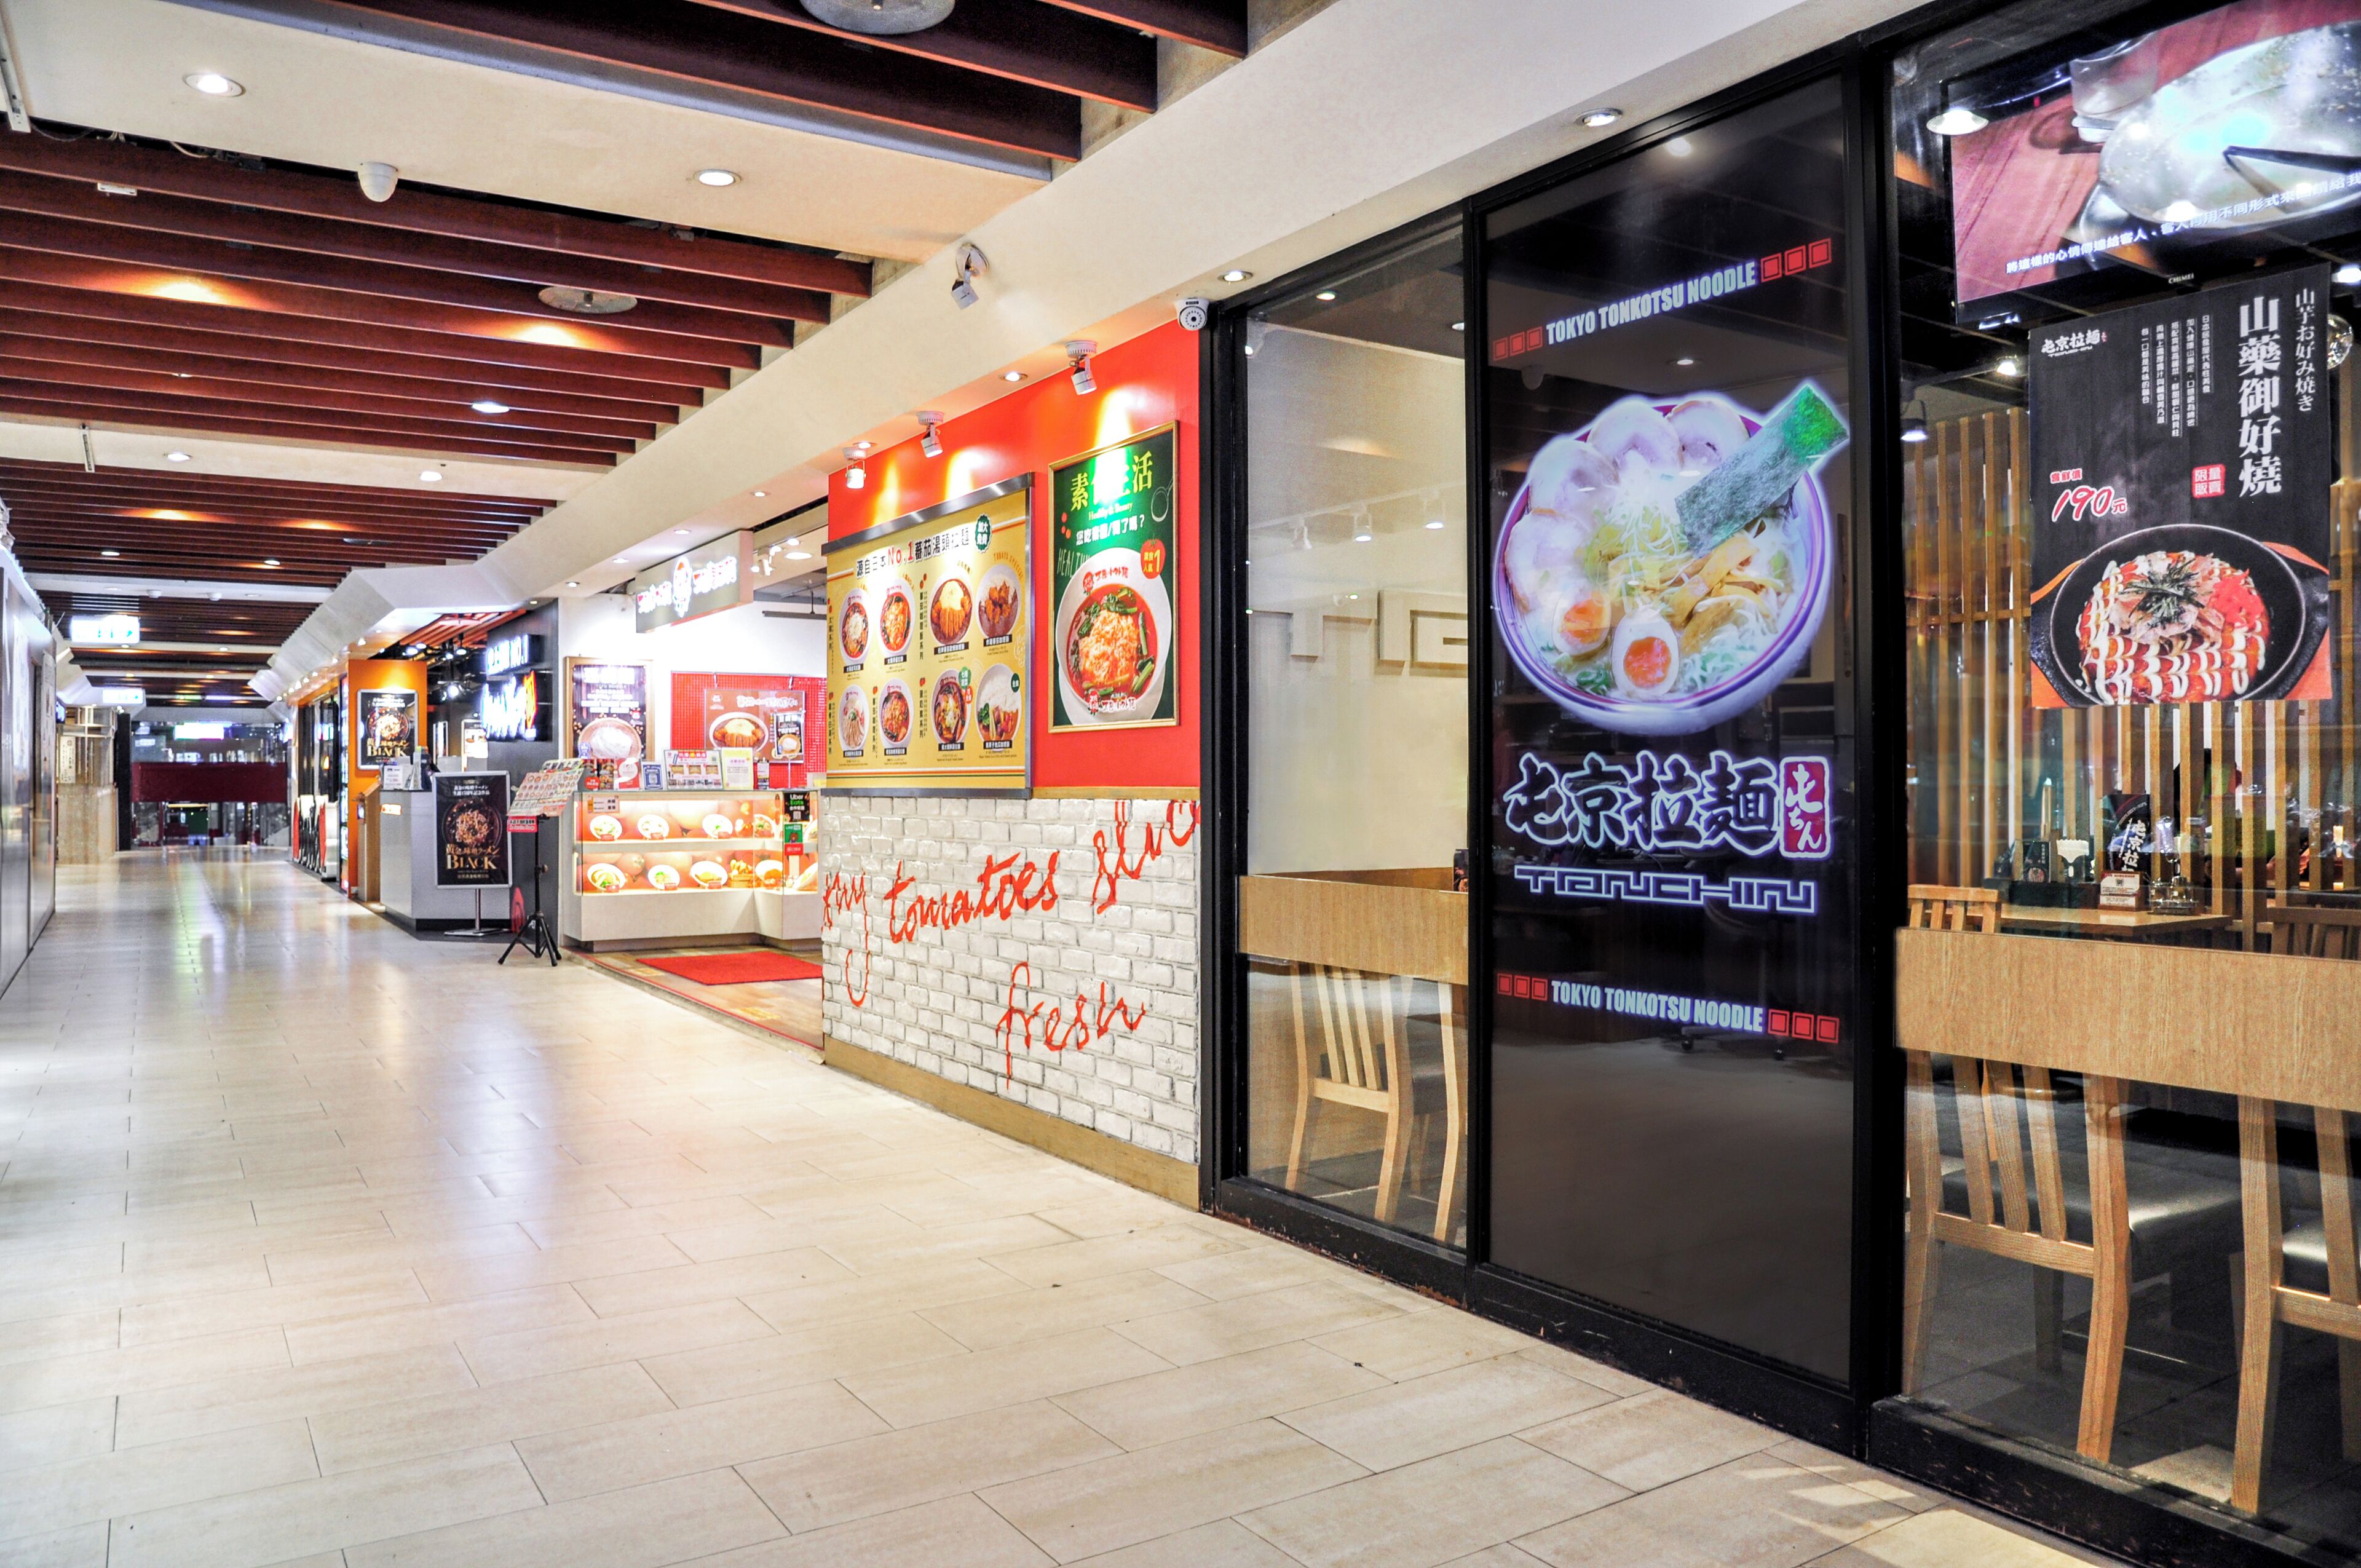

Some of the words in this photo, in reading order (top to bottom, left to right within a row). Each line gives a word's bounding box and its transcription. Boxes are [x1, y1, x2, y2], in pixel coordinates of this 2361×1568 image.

[1546, 311, 1596, 346] TOKYO
[1599, 283, 1684, 331] TONKOTSU
[1687, 261, 1756, 305] NOODLE
[2169, 273, 2194, 284] CHIMEI
[2296, 288, 2316, 411] 山芋お好み焼き
[2238, 296, 2282, 497] 山藥御好燒
[2194, 467, 2221, 482] 限量
[2052, 485, 2127, 522] 190元
[1154, 549, 1161, 572] 1
[446, 854, 497, 870] BLACK
[884, 852, 1059, 943] tomatoes
[996, 961, 1147, 1091] fresh
[1551, 980, 1600, 1009] TOKYO
[1604, 987, 1691, 1021] TONKOTSU
[1694, 999, 1763, 1033] NOODLE
